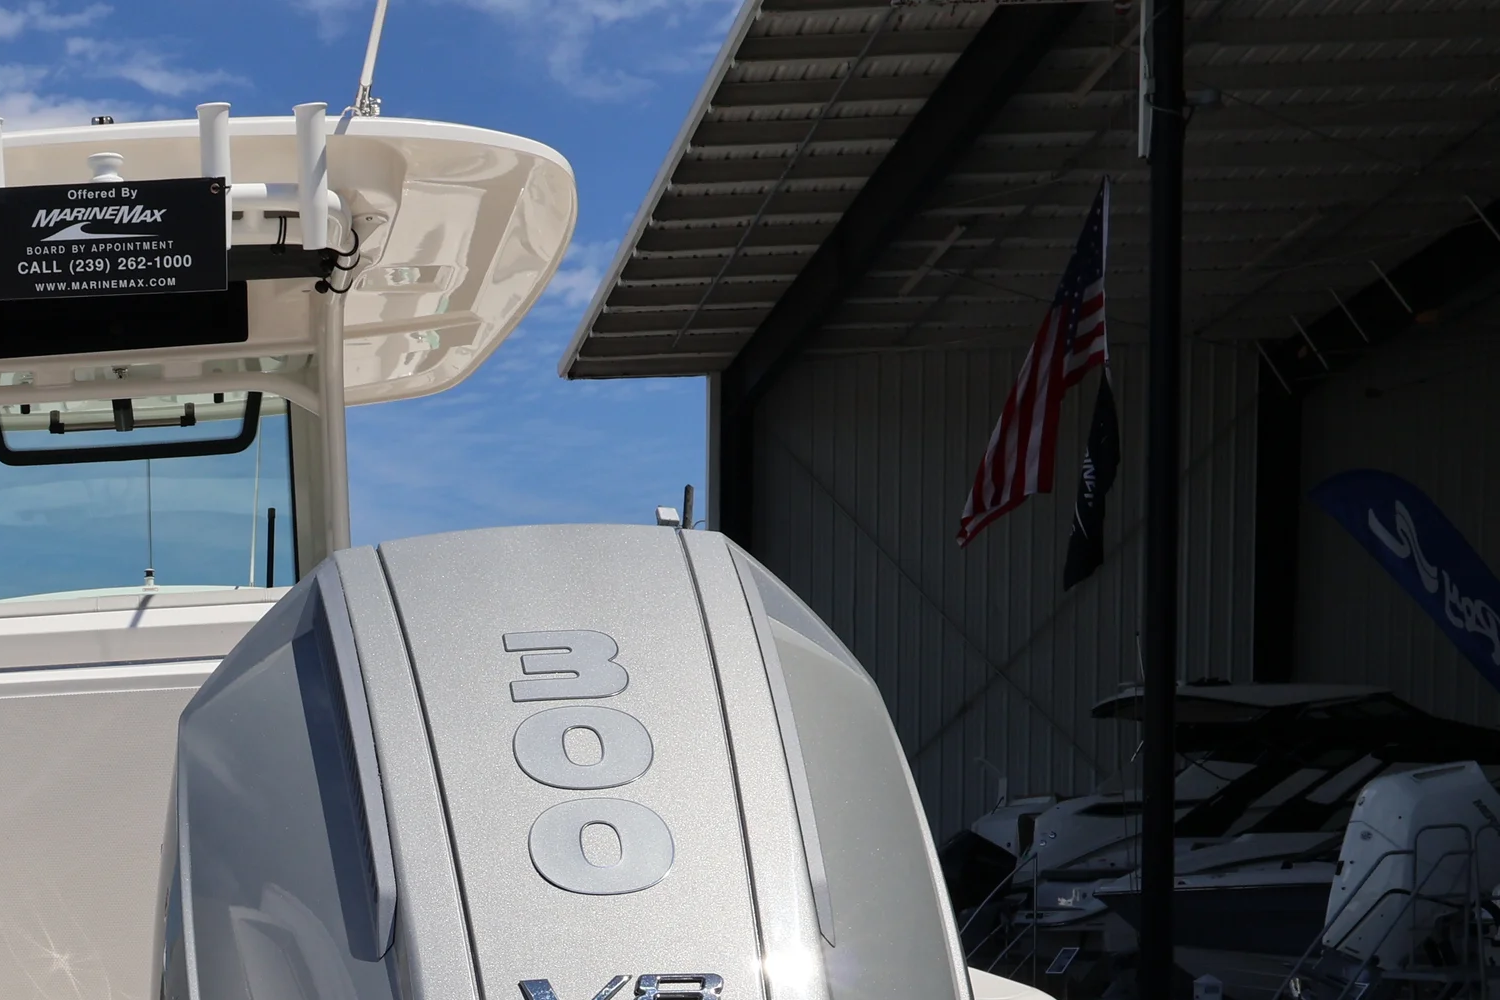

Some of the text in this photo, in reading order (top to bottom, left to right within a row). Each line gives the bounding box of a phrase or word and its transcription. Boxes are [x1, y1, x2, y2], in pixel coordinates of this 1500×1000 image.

[67, 187, 138, 200] Offered By
[26, 240, 174, 256] BOARD BY APPOINTMENT
[17, 254, 192, 275] CALL (239) 262-1000
[35, 277, 176, 292] WWW.MARINEMAX.COM
[502, 629, 675, 896] 300
